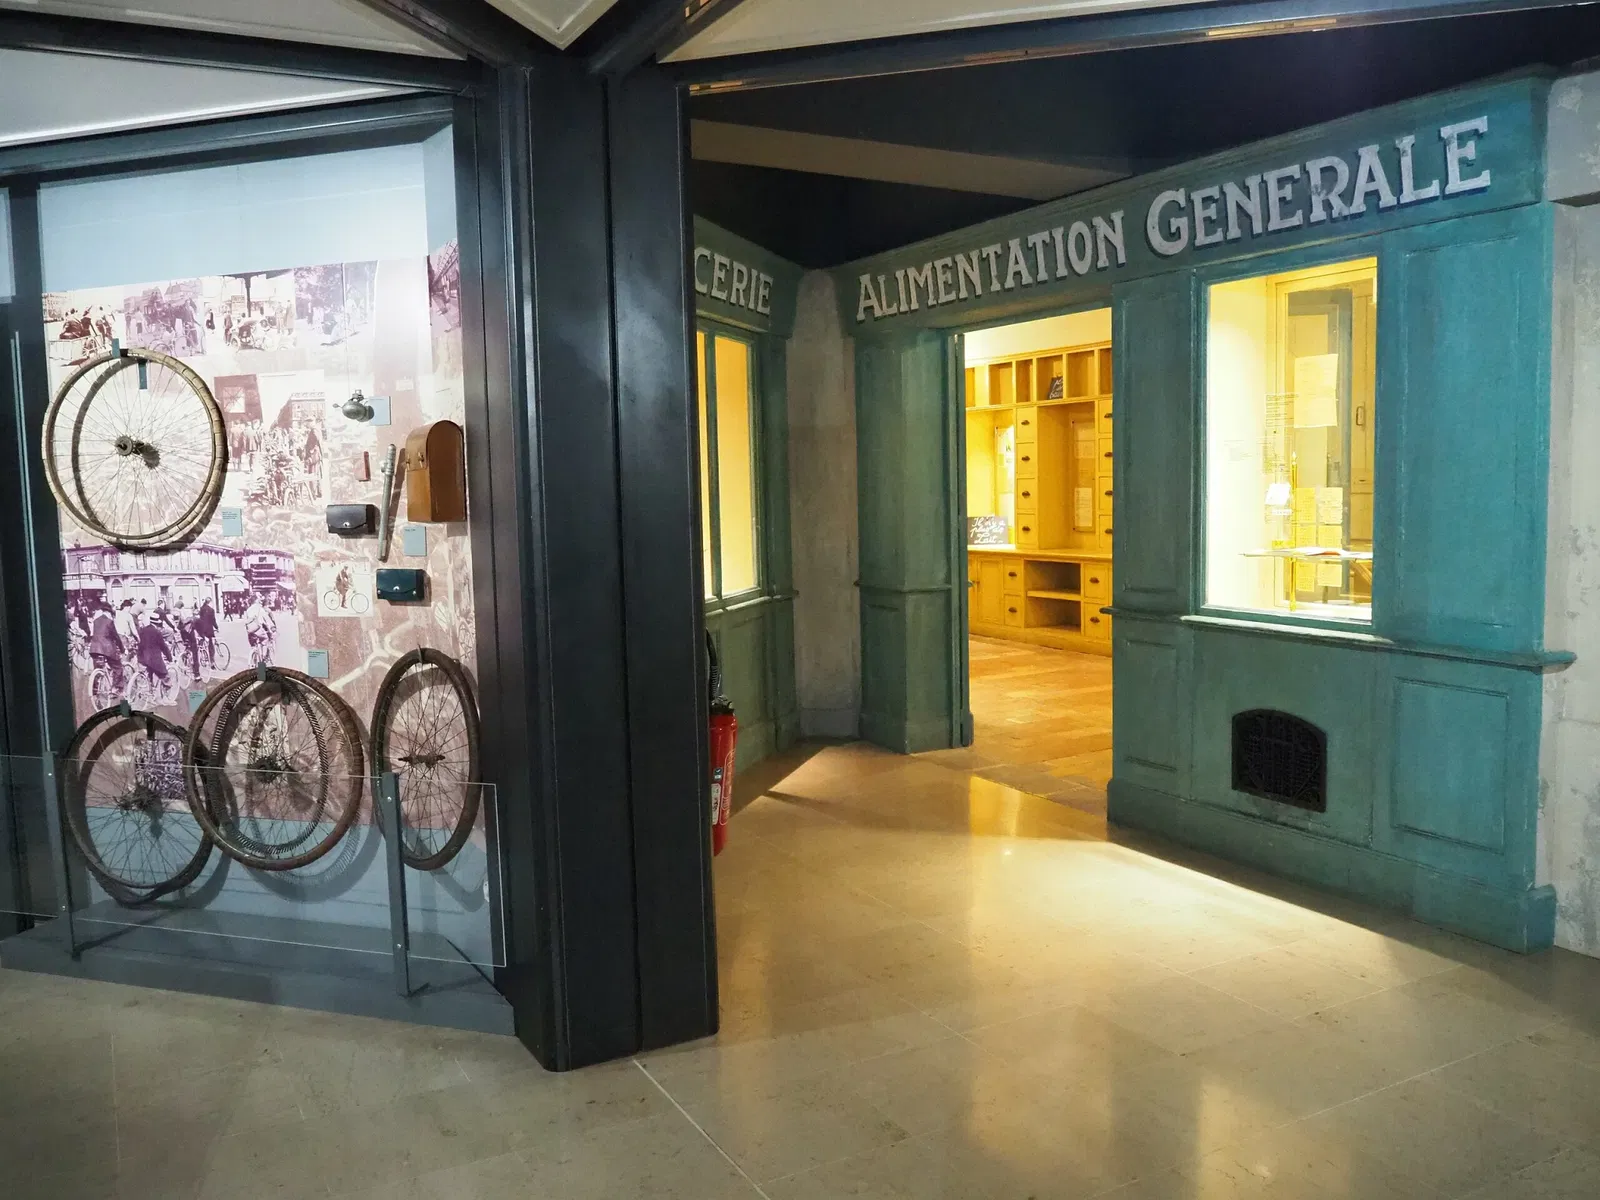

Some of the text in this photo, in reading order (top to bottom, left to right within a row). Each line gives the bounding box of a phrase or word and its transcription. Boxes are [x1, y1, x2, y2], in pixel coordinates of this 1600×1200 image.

[694, 246, 774, 315] CERIE
[856, 116, 1491, 321] ALIMENTATION GENERALE
